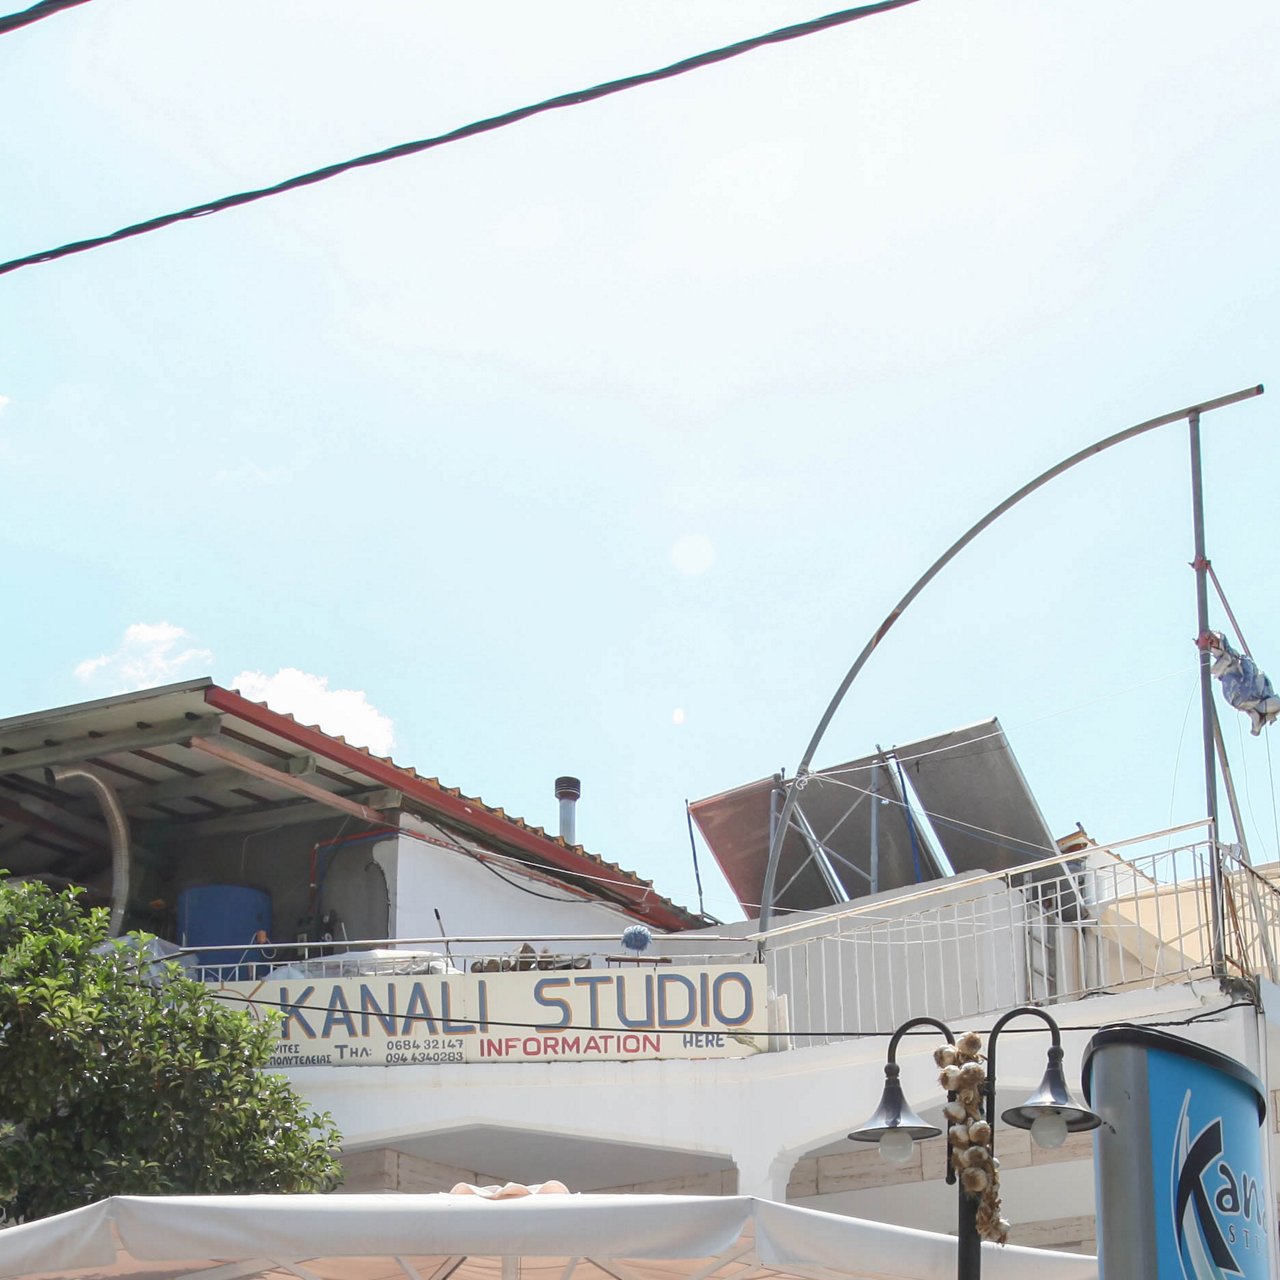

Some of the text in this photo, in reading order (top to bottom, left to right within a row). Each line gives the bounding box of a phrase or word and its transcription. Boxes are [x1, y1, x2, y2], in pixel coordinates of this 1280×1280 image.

[279, 971, 754, 1041] KANALI STUDIO
[479, 1032, 726, 1058] INFORMATION HERE
[1175, 1115, 1268, 1279] Kan
